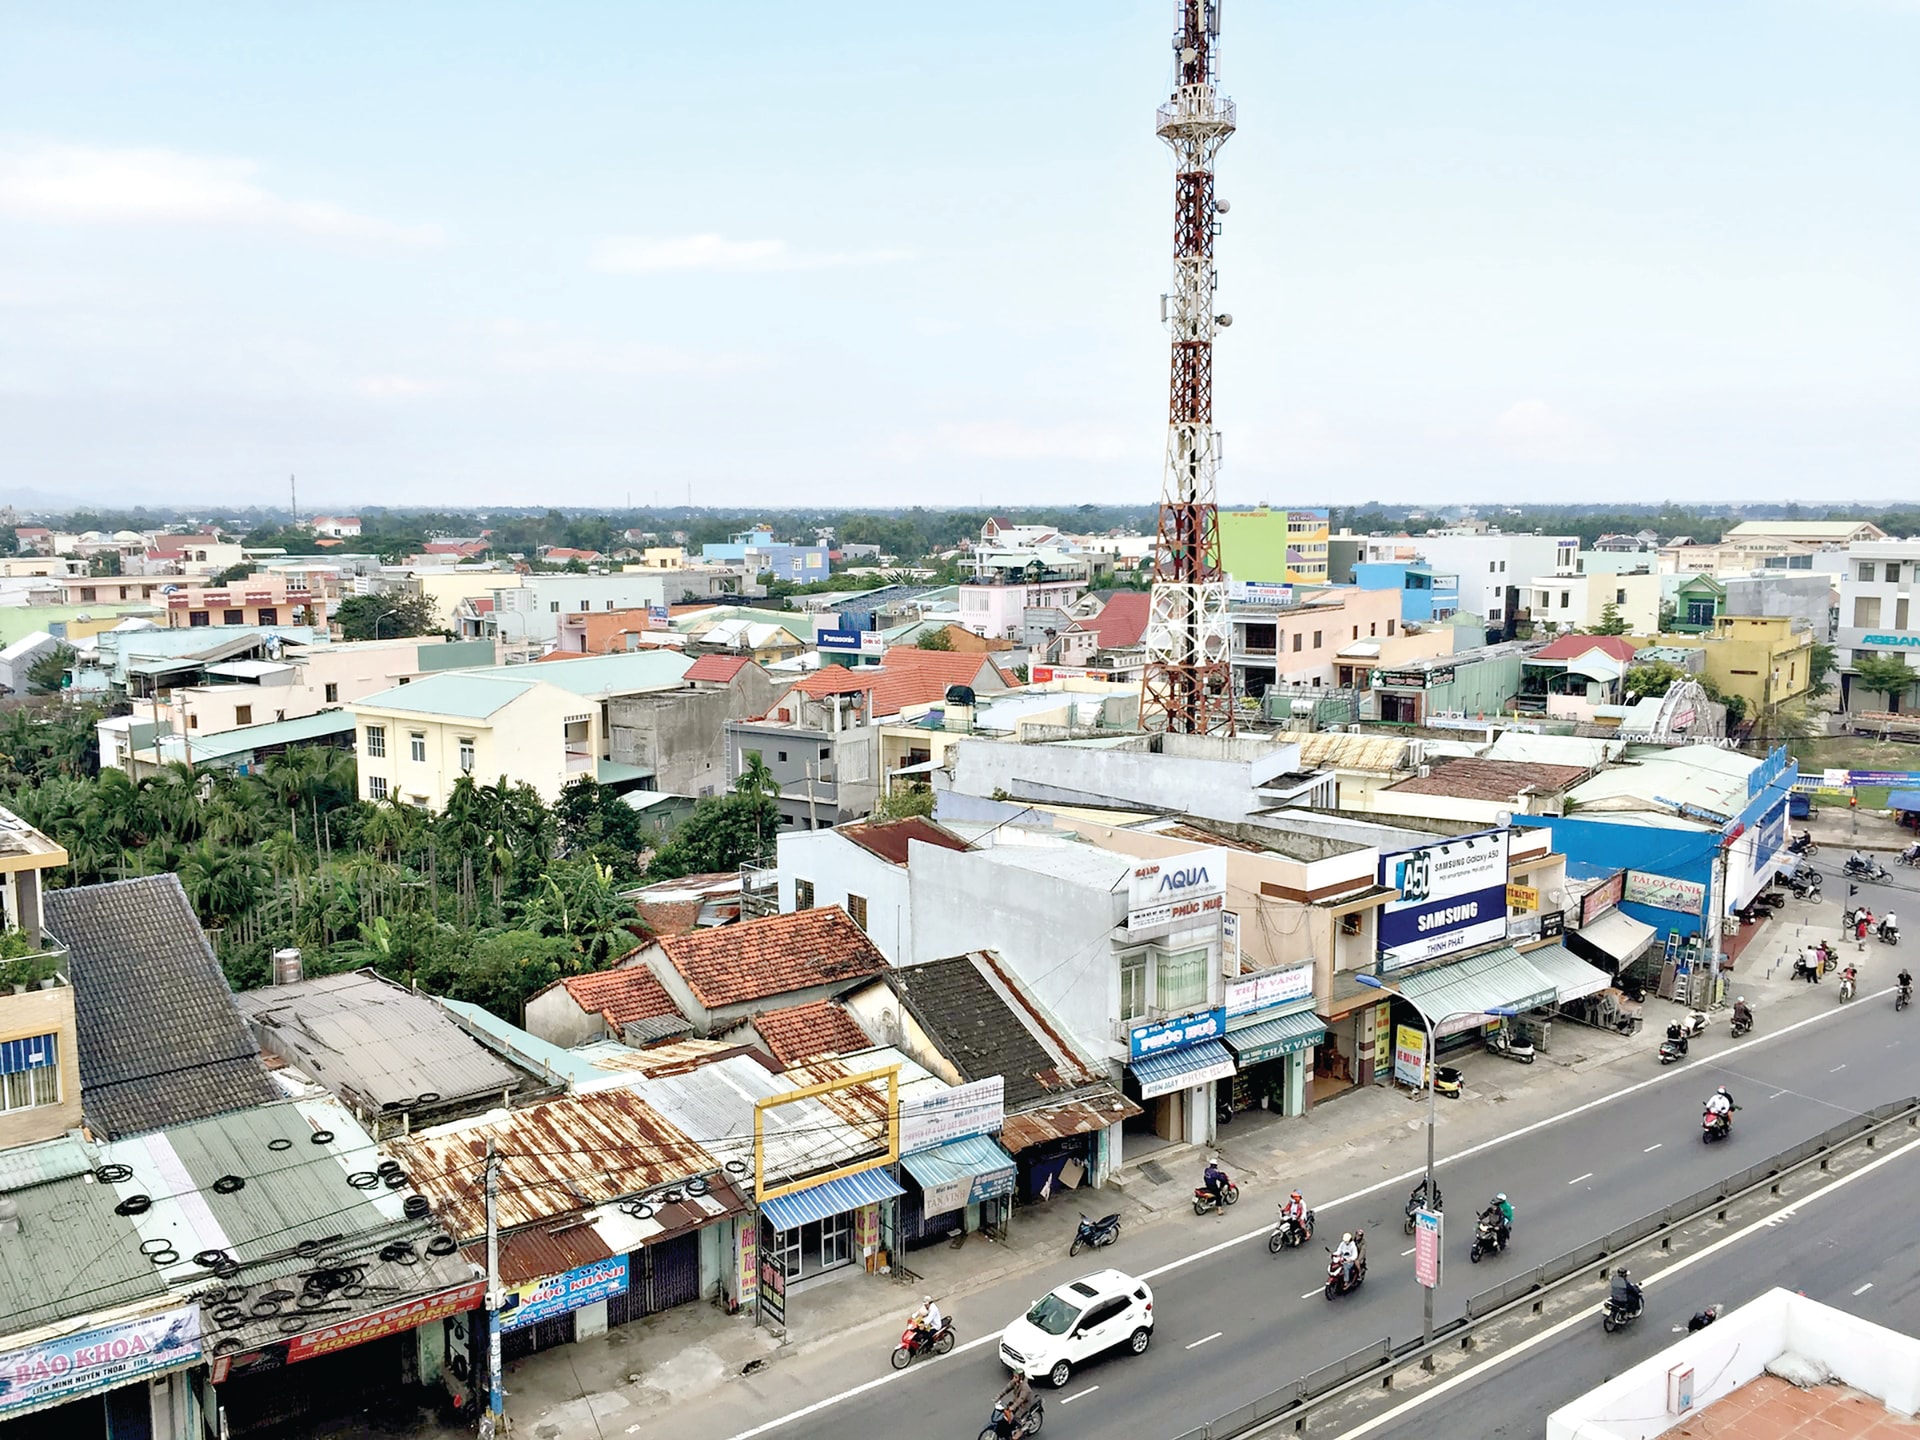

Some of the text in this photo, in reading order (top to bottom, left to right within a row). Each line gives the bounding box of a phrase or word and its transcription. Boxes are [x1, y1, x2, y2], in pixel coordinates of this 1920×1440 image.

[823, 634, 856, 643] Panasonic
[1435, 849, 1499, 872] SAMSUNG Galaxy A50
[1159, 866, 1209, 892] AQUA
[1403, 854, 1431, 901] A50
[1417, 902, 1478, 932] SAMSUNG
[521, 1285, 566, 1307] NGỌC
[570, 1265, 625, 1291] KHÁNH
[300, 1287, 476, 1346] KAWAMATSU
[76, 1334, 148, 1369] KHOA
[313, 1324, 390, 1352] HONDA
[52, 1378, 73, 1391] MINH
[133, 1357, 149, 1369] FIFA
